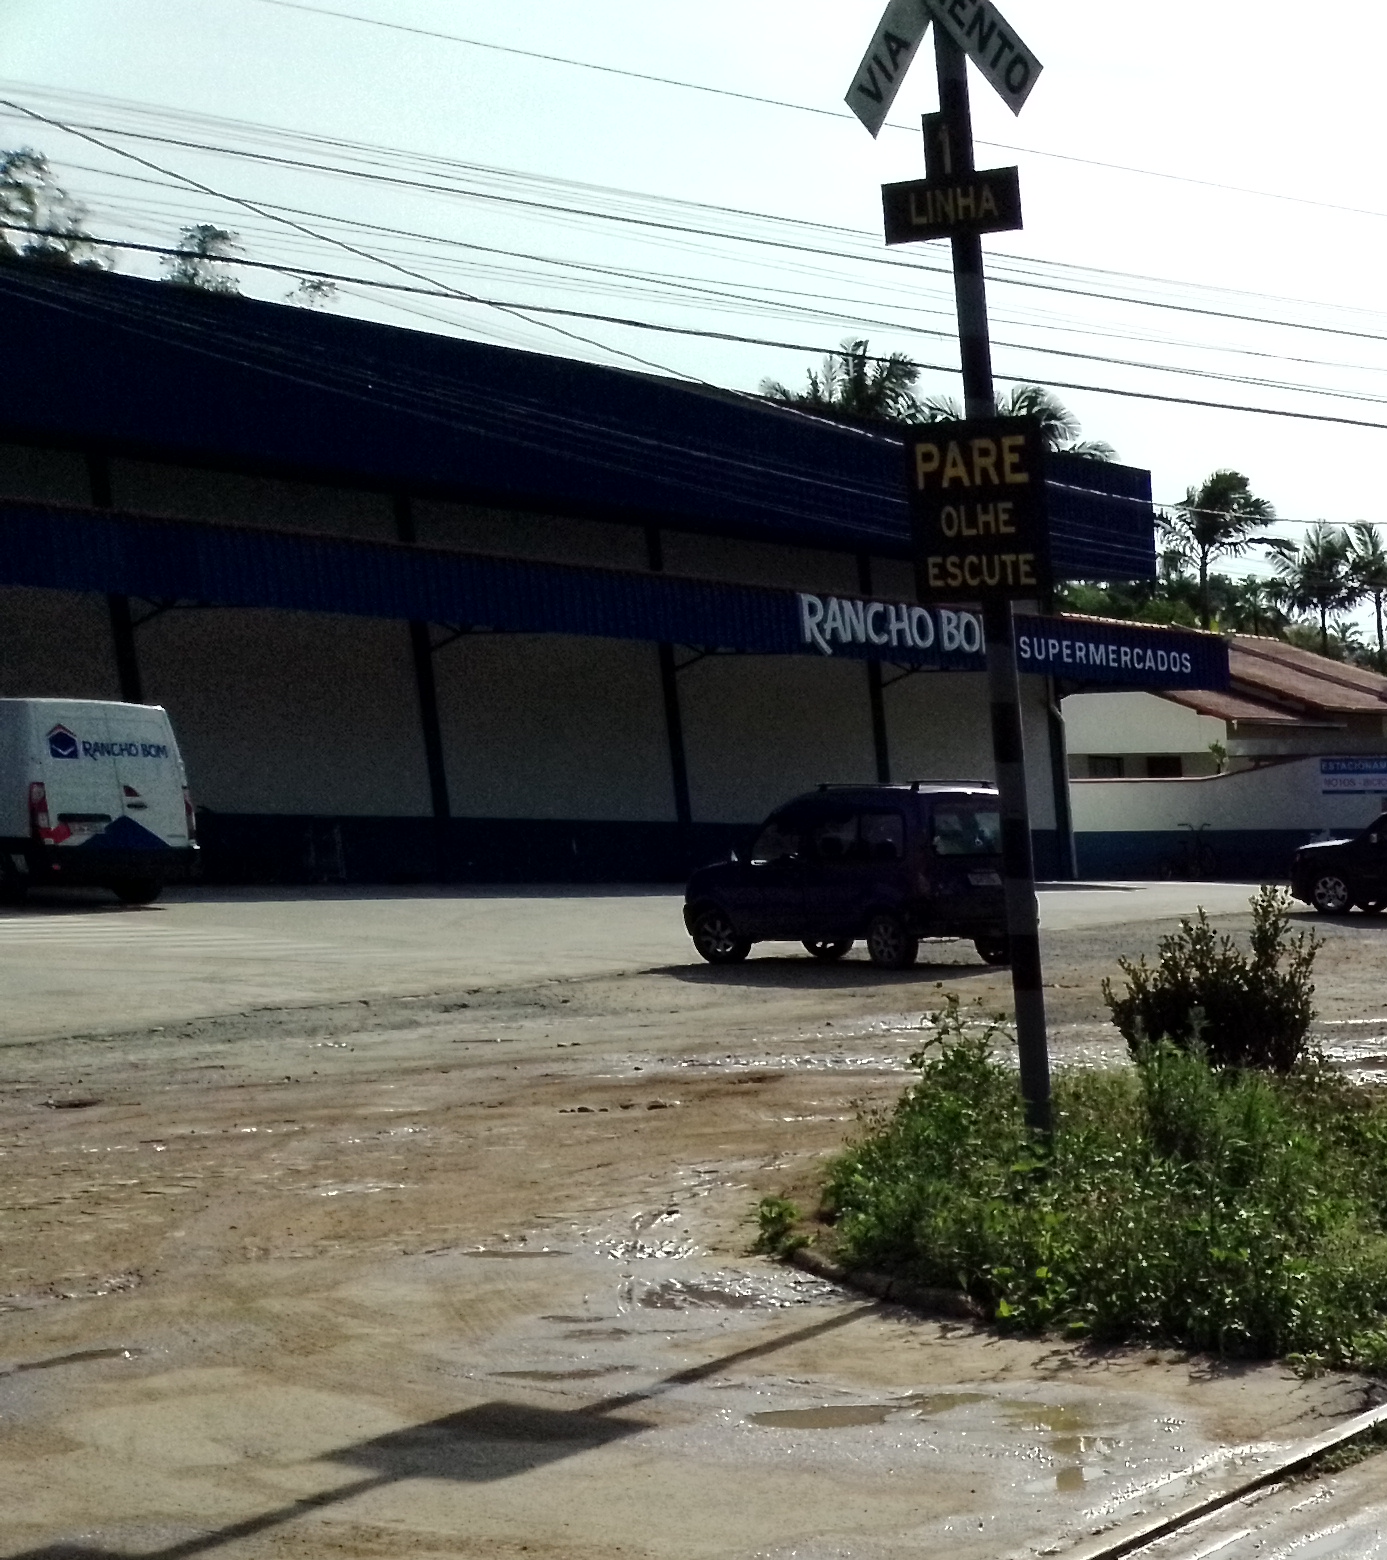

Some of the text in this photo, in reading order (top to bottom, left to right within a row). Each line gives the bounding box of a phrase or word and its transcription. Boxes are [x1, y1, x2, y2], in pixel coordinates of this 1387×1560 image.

[857, 29, 911, 104] VIA
[942, 0, 1031, 96] ENTO
[937, 123, 952, 175] 1
[909, 184, 999, 226] LINHA
[914, 435, 1029, 490] PARE
[940, 501, 1016, 537] OLHE
[927, 553, 1037, 588] ESCUTE
[797, 592, 986, 655] RANCHO BO
[1018, 635, 1192, 674] SUPERMERCADOS
[82, 740, 168, 760] RANCHO BOM
